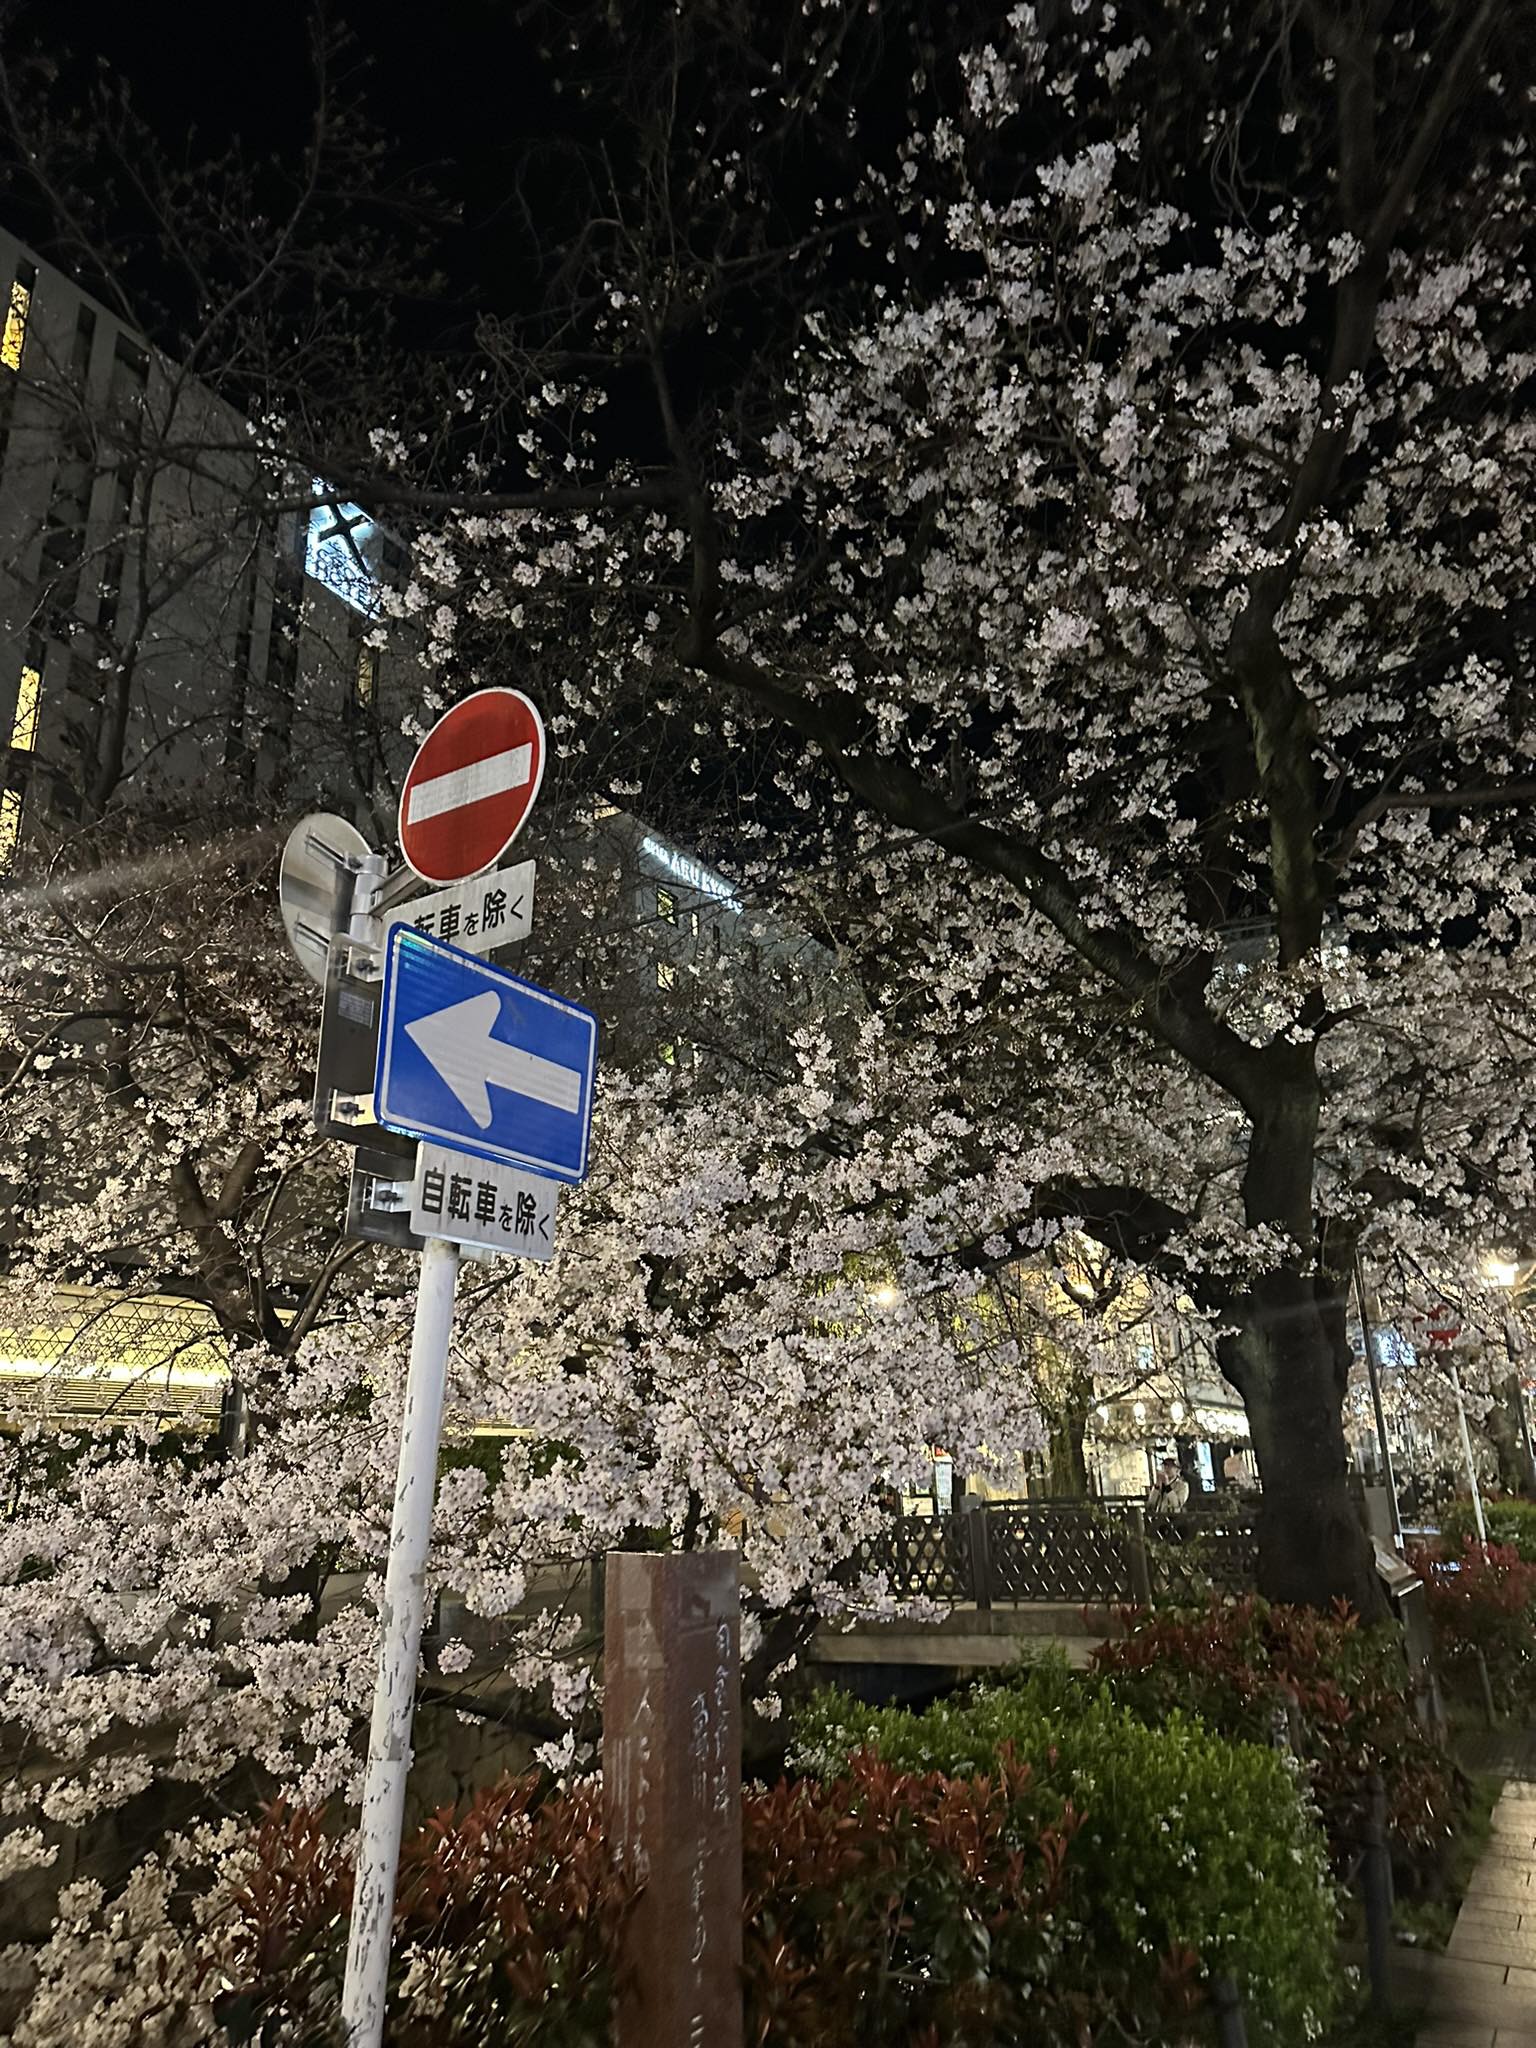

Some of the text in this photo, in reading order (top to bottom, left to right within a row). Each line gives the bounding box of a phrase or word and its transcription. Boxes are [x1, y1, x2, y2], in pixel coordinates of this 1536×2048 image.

[317, 549, 377, 597] CROS
[413, 888, 524, 943] 転車を除く
[421, 1166, 550, 1241] 自転車を除く
